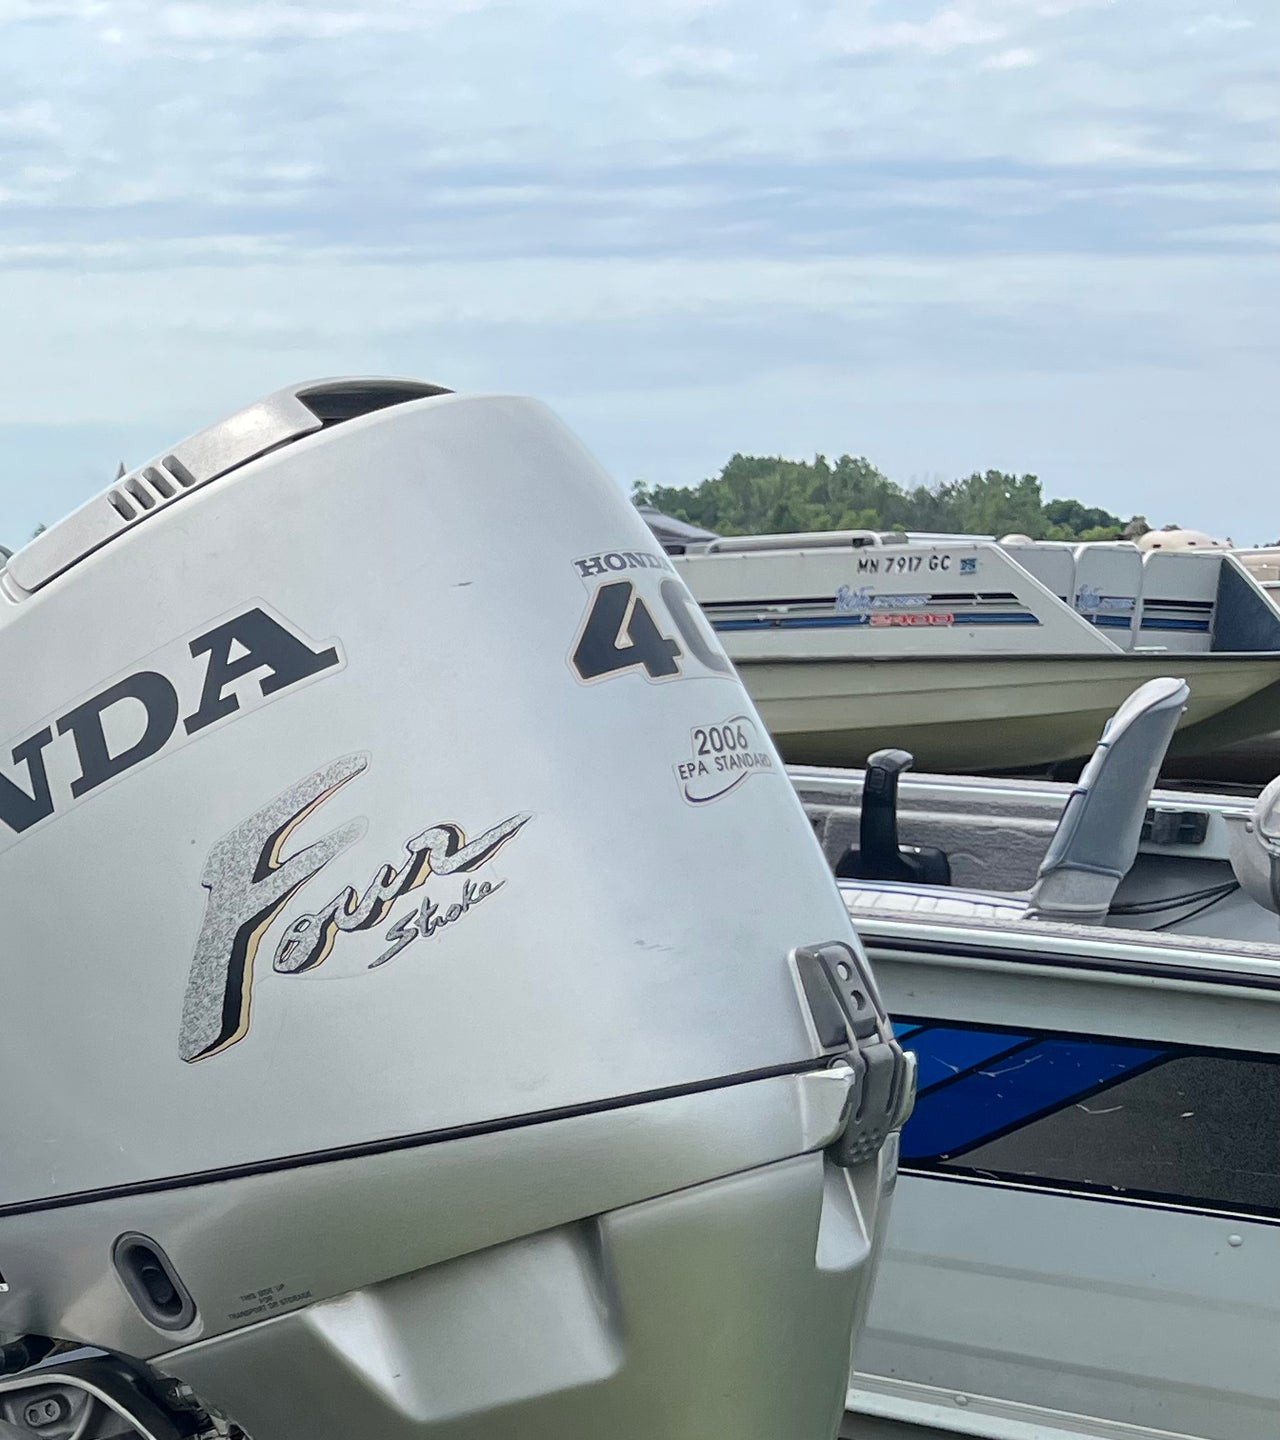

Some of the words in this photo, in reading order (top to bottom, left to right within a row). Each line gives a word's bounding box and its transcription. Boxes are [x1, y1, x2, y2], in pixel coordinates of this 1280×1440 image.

[857, 558, 879, 574] MN
[885, 557, 923, 574] 7917
[928, 555, 952, 571] GC
[694, 726, 749, 756] 2006
[677, 762, 709, 781] EPA
[714, 751, 772, 772] STANDARD
[178, 752, 534, 1063] Four
[368, 878, 506, 971] Stroke
